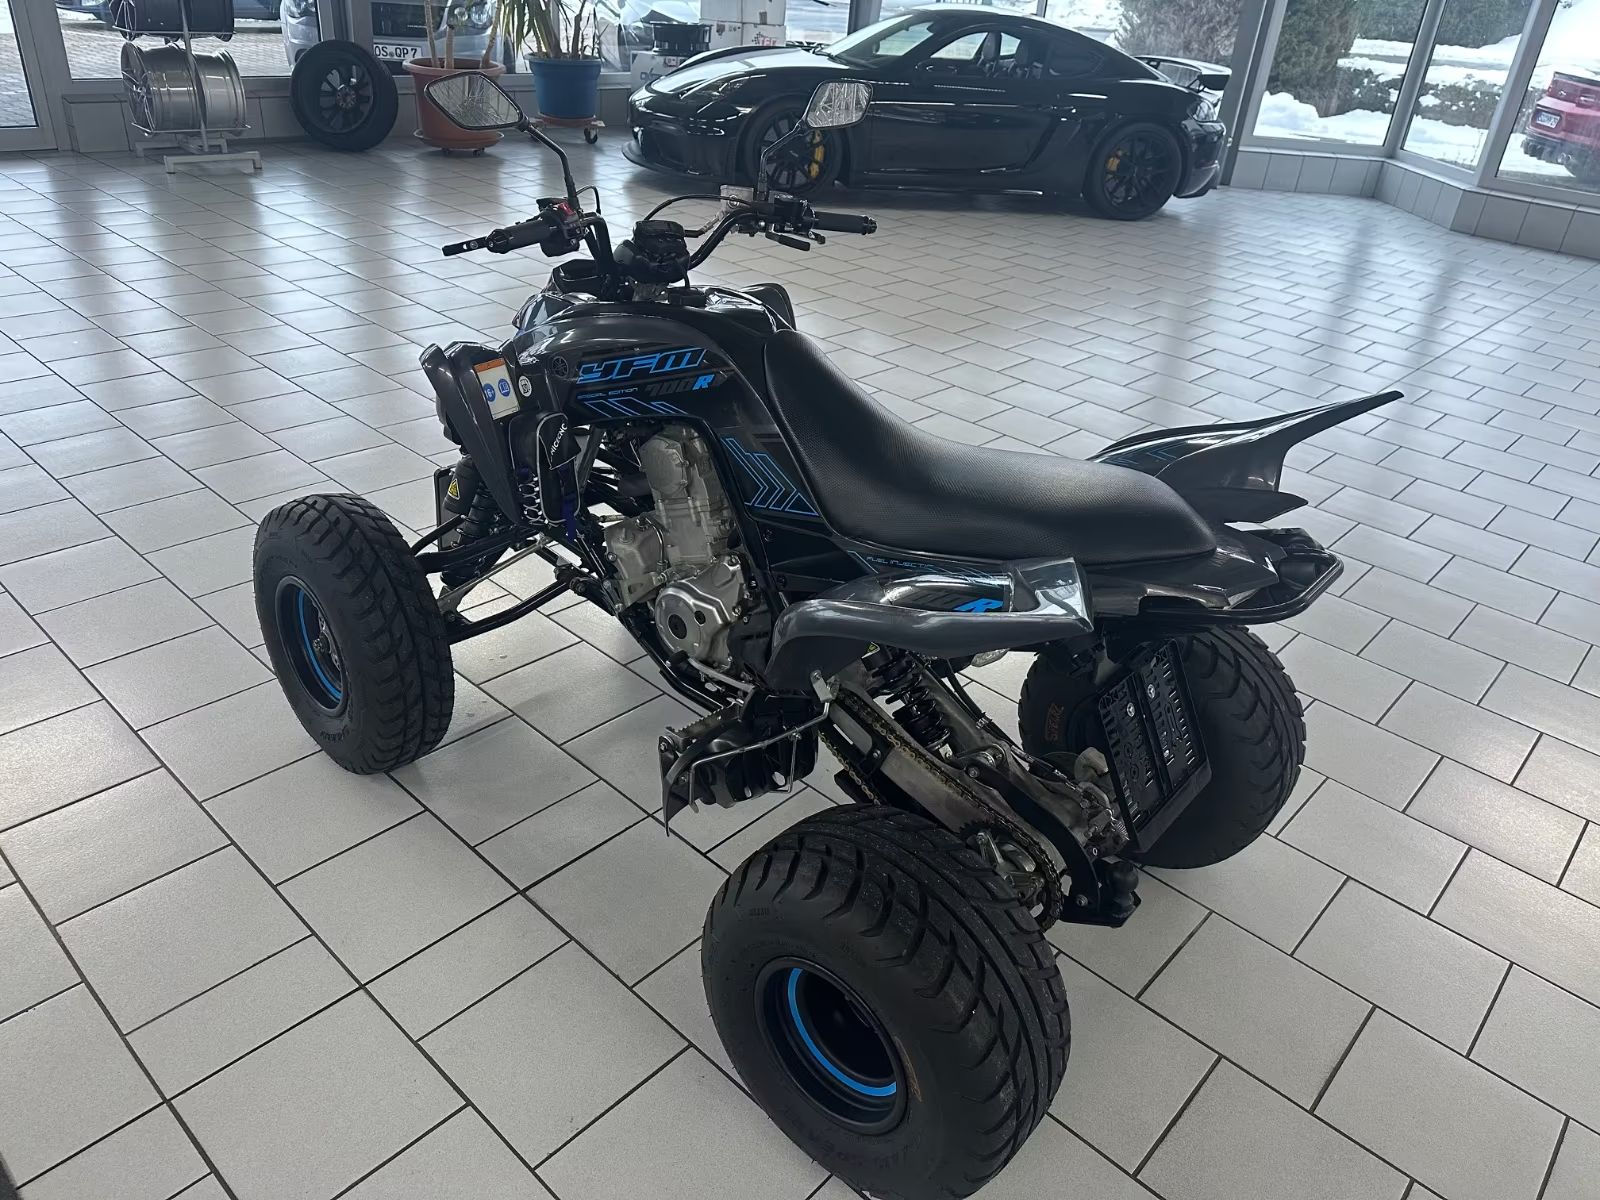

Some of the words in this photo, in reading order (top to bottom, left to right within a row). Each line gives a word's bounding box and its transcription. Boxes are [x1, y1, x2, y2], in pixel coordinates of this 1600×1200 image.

[374, 45, 389, 57] OS
[394, 46, 409, 58] QP
[410, 47, 418, 59] 7
[576, 346, 707, 385] YFM
